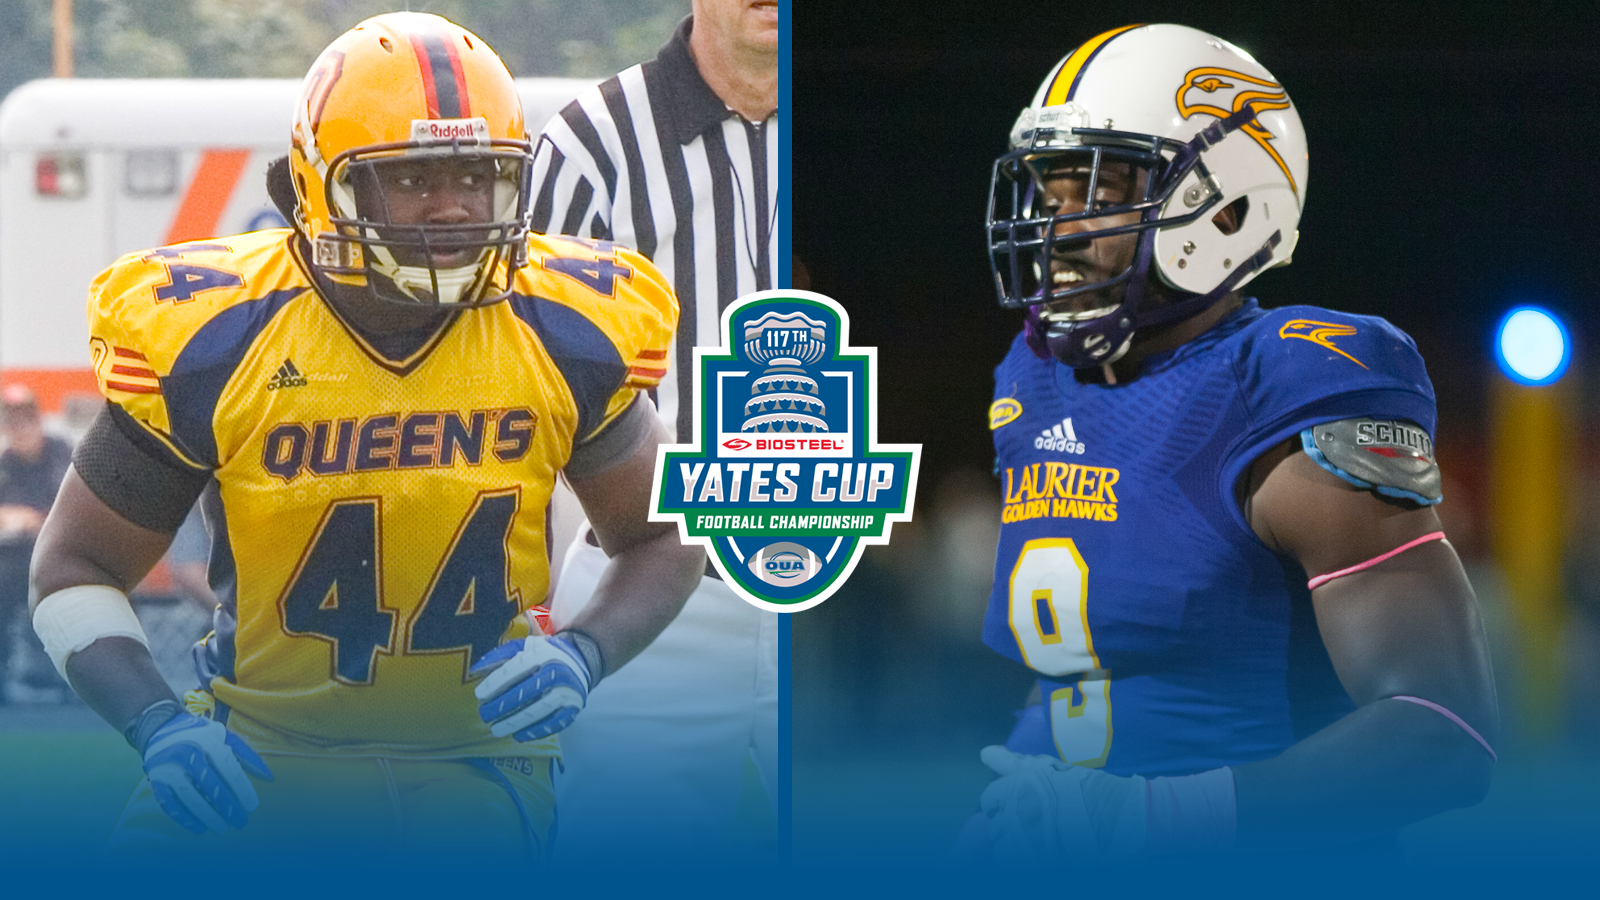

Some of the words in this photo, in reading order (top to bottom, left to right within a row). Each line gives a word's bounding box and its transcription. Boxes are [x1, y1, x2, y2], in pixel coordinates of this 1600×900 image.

[430, 123, 474, 138] Riddell
[266, 376, 308, 391] adidas
[262, 406, 538, 485] QUEEN'S
[1034, 436, 1086, 455] adidas
[1005, 461, 1121, 504] LAURIER
[1002, 498, 1050, 524] GOLDEN
[1052, 498, 1119, 522] HAWKS
[276, 484, 523, 686] 44
[1008, 537, 1114, 769] 9
